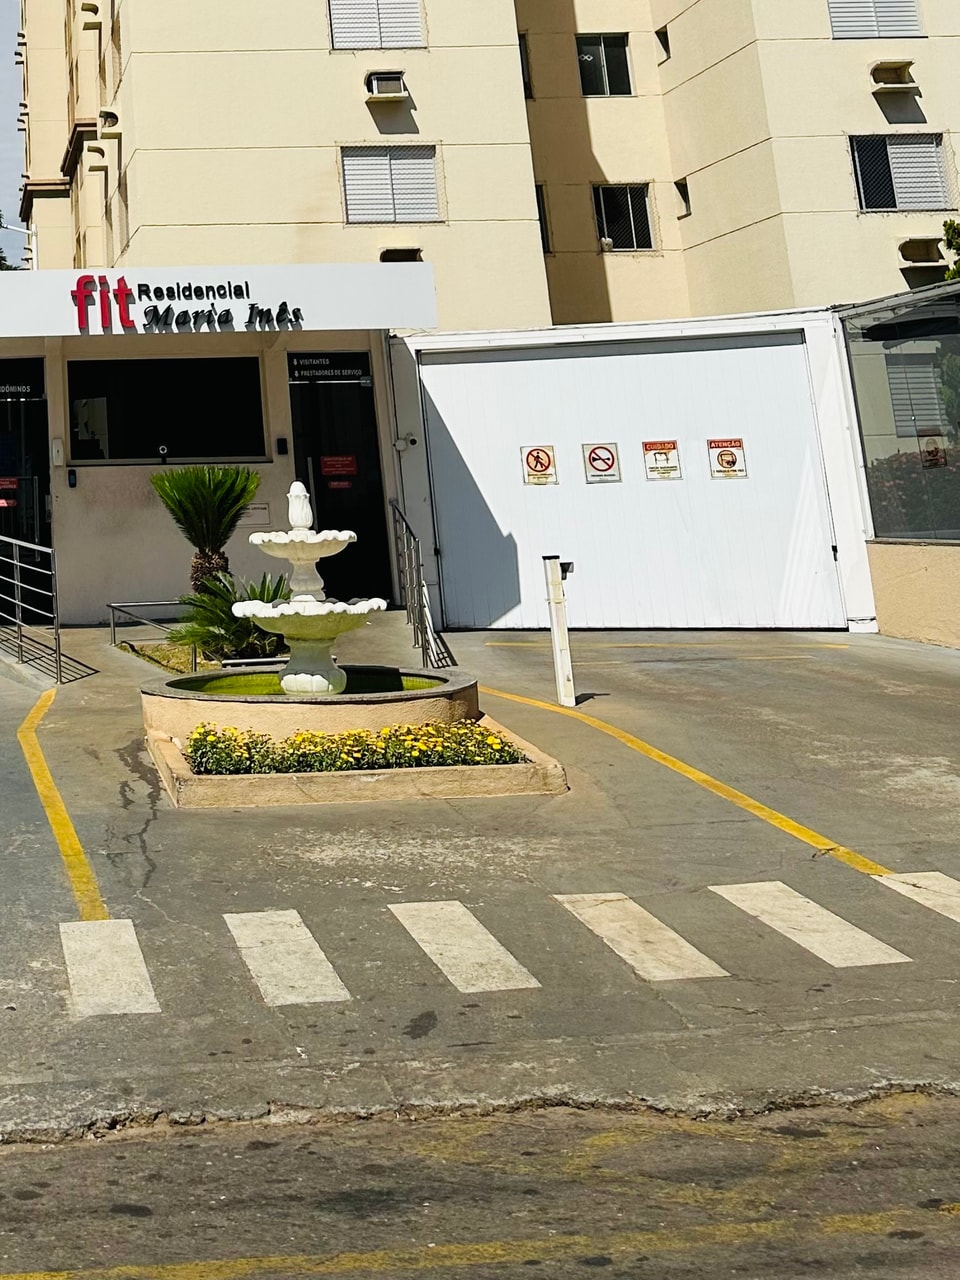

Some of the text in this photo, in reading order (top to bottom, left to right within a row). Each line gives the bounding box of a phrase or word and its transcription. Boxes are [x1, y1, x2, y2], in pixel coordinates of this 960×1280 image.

[137, 281, 251, 301] Residencial
[71, 275, 136, 329] fit
[143, 302, 304, 328] Maria Inês
[301, 369, 334, 377] PRESTADORES
[342, 368, 363, 376] SERVIÇO
[710, 440, 740, 448] ATENÇÃO
